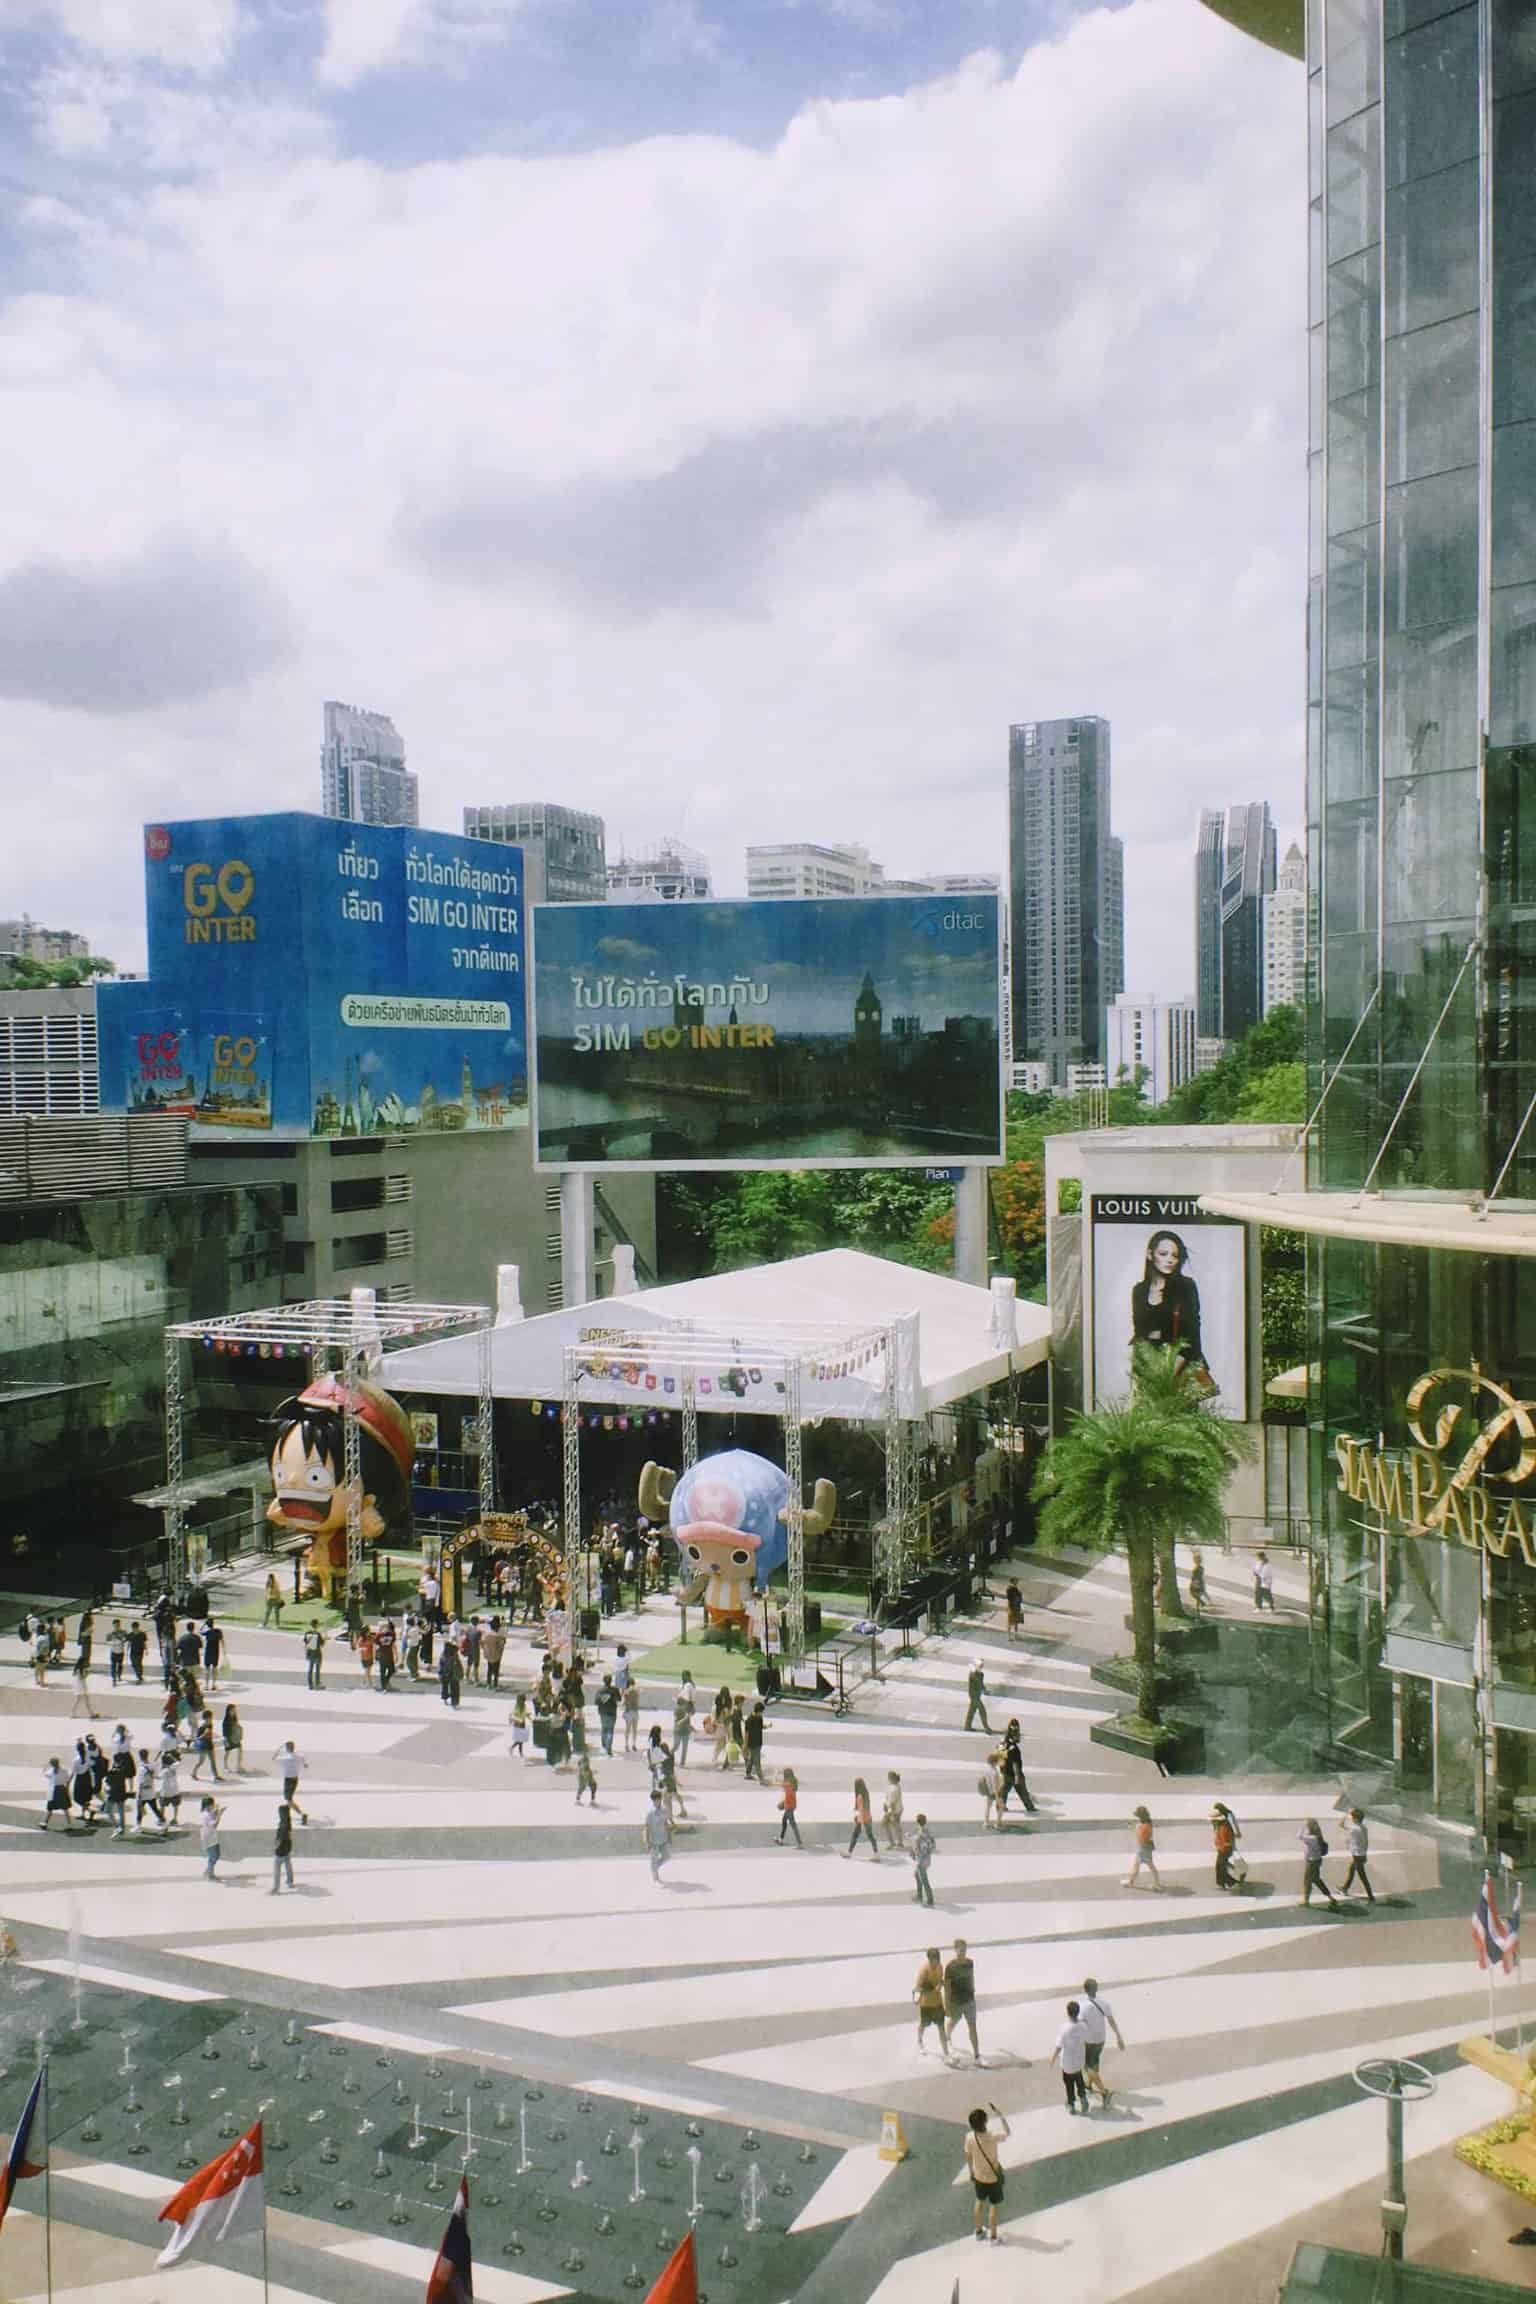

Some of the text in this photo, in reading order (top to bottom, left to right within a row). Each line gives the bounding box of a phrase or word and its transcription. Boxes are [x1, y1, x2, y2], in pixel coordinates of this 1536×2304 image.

[338, 840, 518, 899] เที่ยว ทั่วโลกได้สุดกว่า
[183, 860, 256, 917] GO
[342, 890, 518, 935] เลือก SIM GO INTER
[943, 910, 985, 930] dtac
[184, 916, 256, 944] INTER
[452, 944, 519, 972] จากดีแทค
[571, 971, 769, 1009] ไปได้ทั่วโลกกับ
[138, 1032, 179, 1066] GO
[214, 1034, 256, 1067] GO
[573, 1023, 776, 1052] SIM GO INTER
[1097, 1199, 1151, 1216] LOUIS
[1407, 1447, 1536, 1568] PARA
